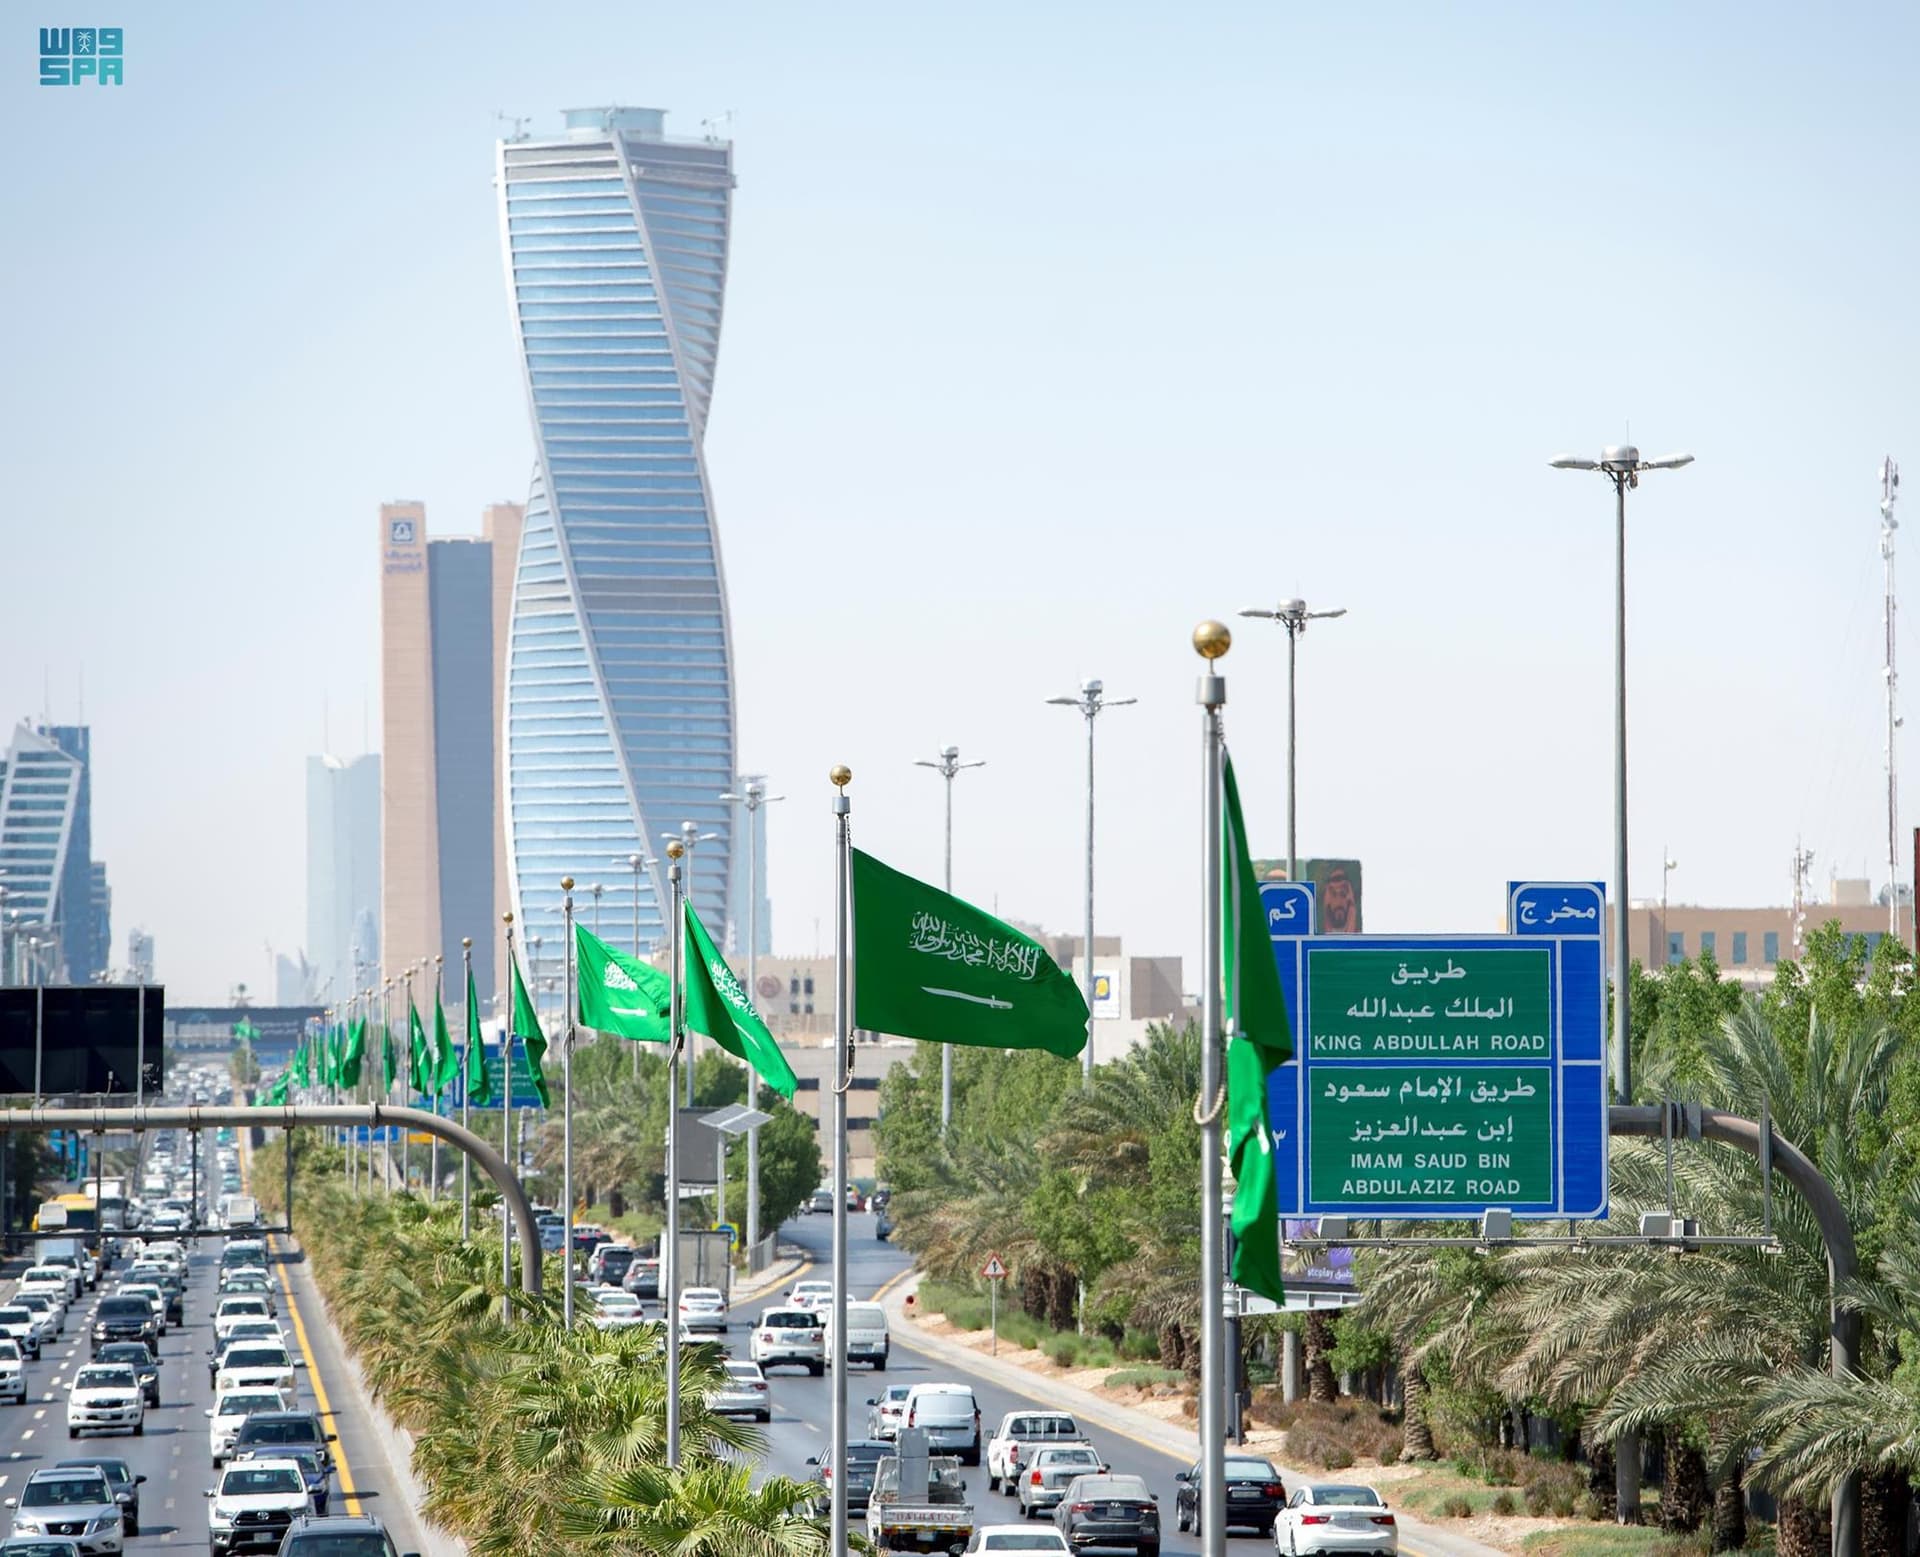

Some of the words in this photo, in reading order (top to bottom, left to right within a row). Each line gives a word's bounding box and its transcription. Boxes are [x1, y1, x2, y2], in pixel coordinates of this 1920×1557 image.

[1269, 898, 1298, 927] كم
[1520, 898, 1597, 924] مخرج
[1391, 958, 1467, 985] طريق
[1346, 997, 1435, 1023] عبدالله
[1444, 997, 1513, 1019] الملك
[1314, 1034, 1362, 1050] KING
[1373, 1034, 1479, 1050] ABDULLAH
[1491, 1034, 1545, 1050] ROAD
[1324, 1082, 1391, 1102] سعود
[1399, 1075, 1462, 1103] الإمام
[1470, 1076, 1536, 1103] طريق
[1272, 1129, 1287, 1150] ٣
[1349, 1115, 1468, 1142] عبدالعزيز
[1351, 1153, 1403, 1169] IMAM
[1414, 1153, 1467, 1169] SAUD
[1478, 1153, 1510, 1169] BIN
[1341, 1179, 1455, 1196] ABDULAZIZ
[1466, 1179, 1521, 1196] ROAD
